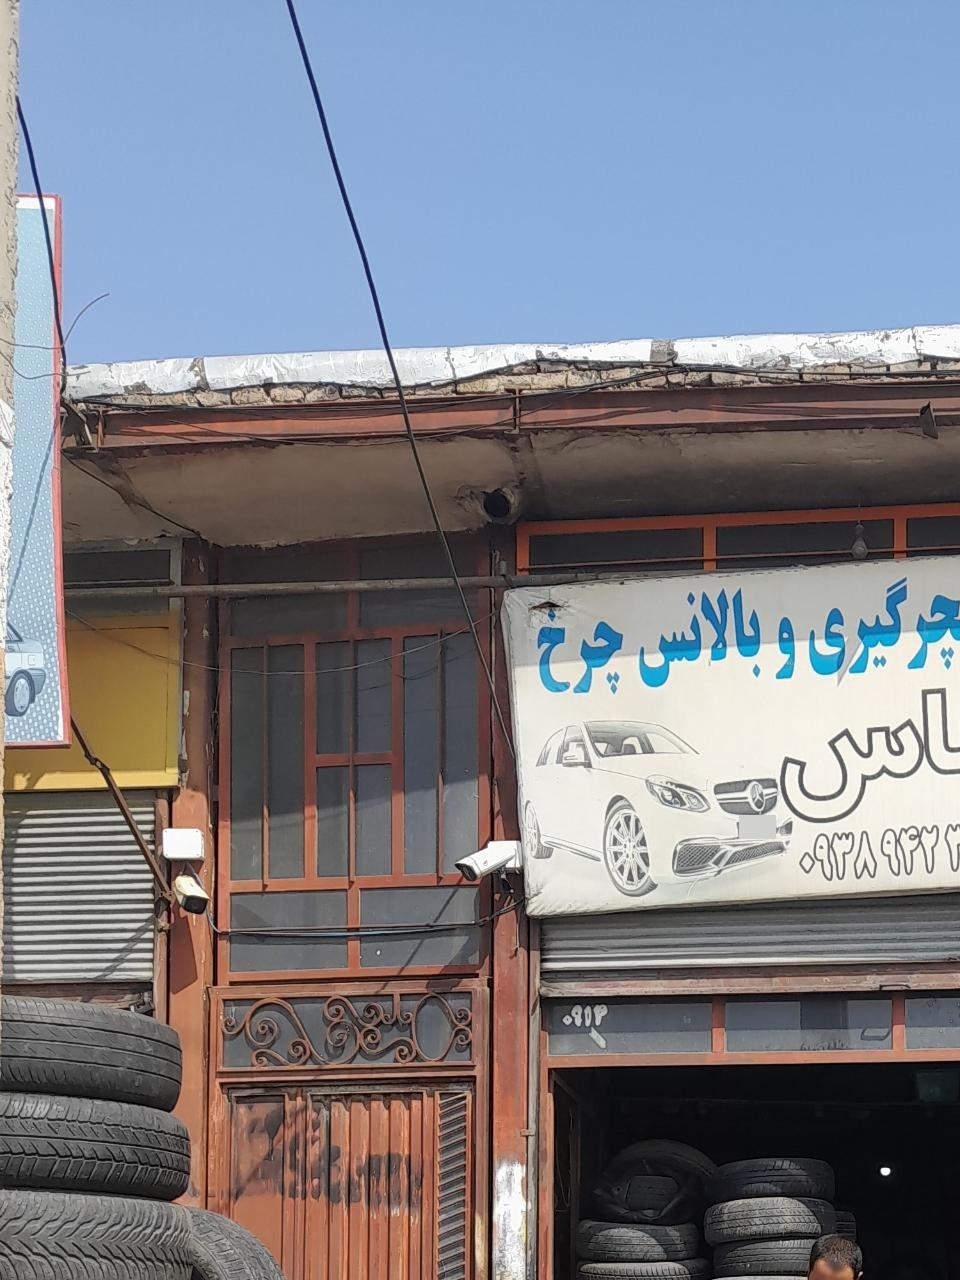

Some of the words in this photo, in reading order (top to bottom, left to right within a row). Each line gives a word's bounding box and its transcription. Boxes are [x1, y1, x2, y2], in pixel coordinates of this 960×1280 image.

[537, 608, 624, 695] چرخ
[639, 587, 762, 689] بالانس
[775, 616, 796, 680] و
